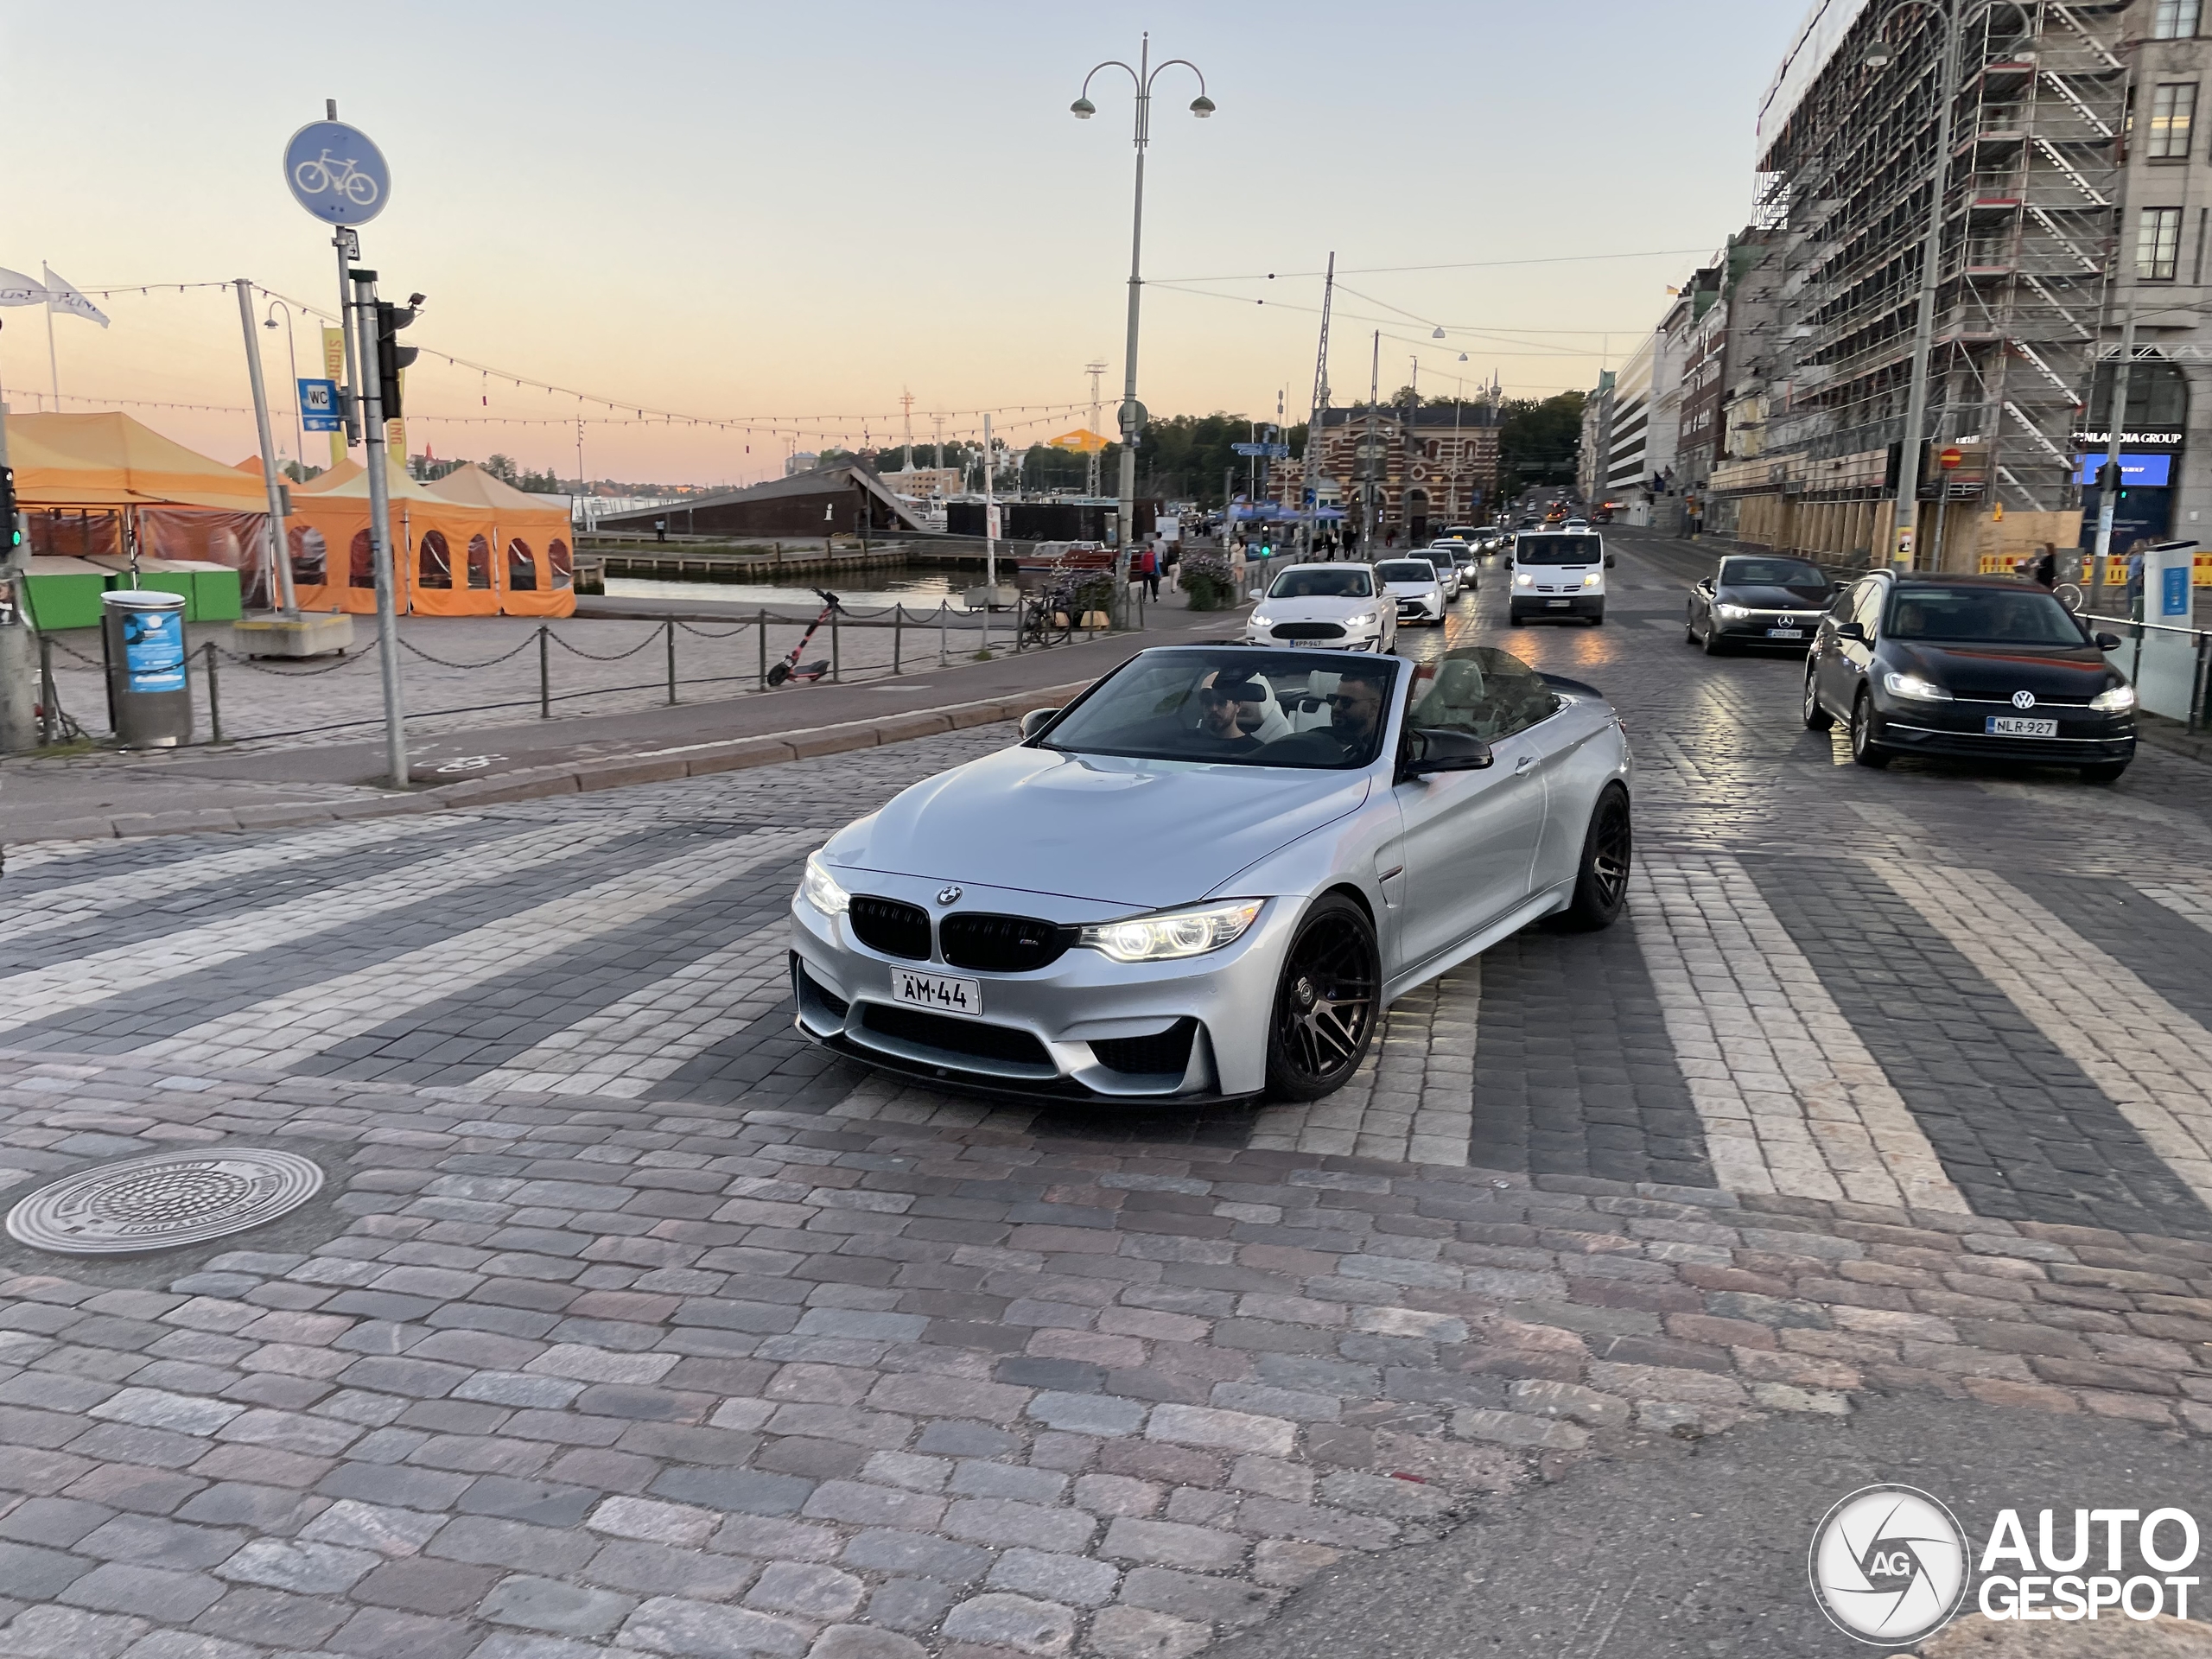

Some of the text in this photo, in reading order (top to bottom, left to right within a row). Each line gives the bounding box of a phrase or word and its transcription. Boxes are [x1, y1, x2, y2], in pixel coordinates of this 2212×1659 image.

[309, 391, 328, 404] WC
[2140, 433, 2183, 443] GROUP
[1997, 721, 2053, 734] NLR-927
[902, 974, 967, 1008] ÄM-44
